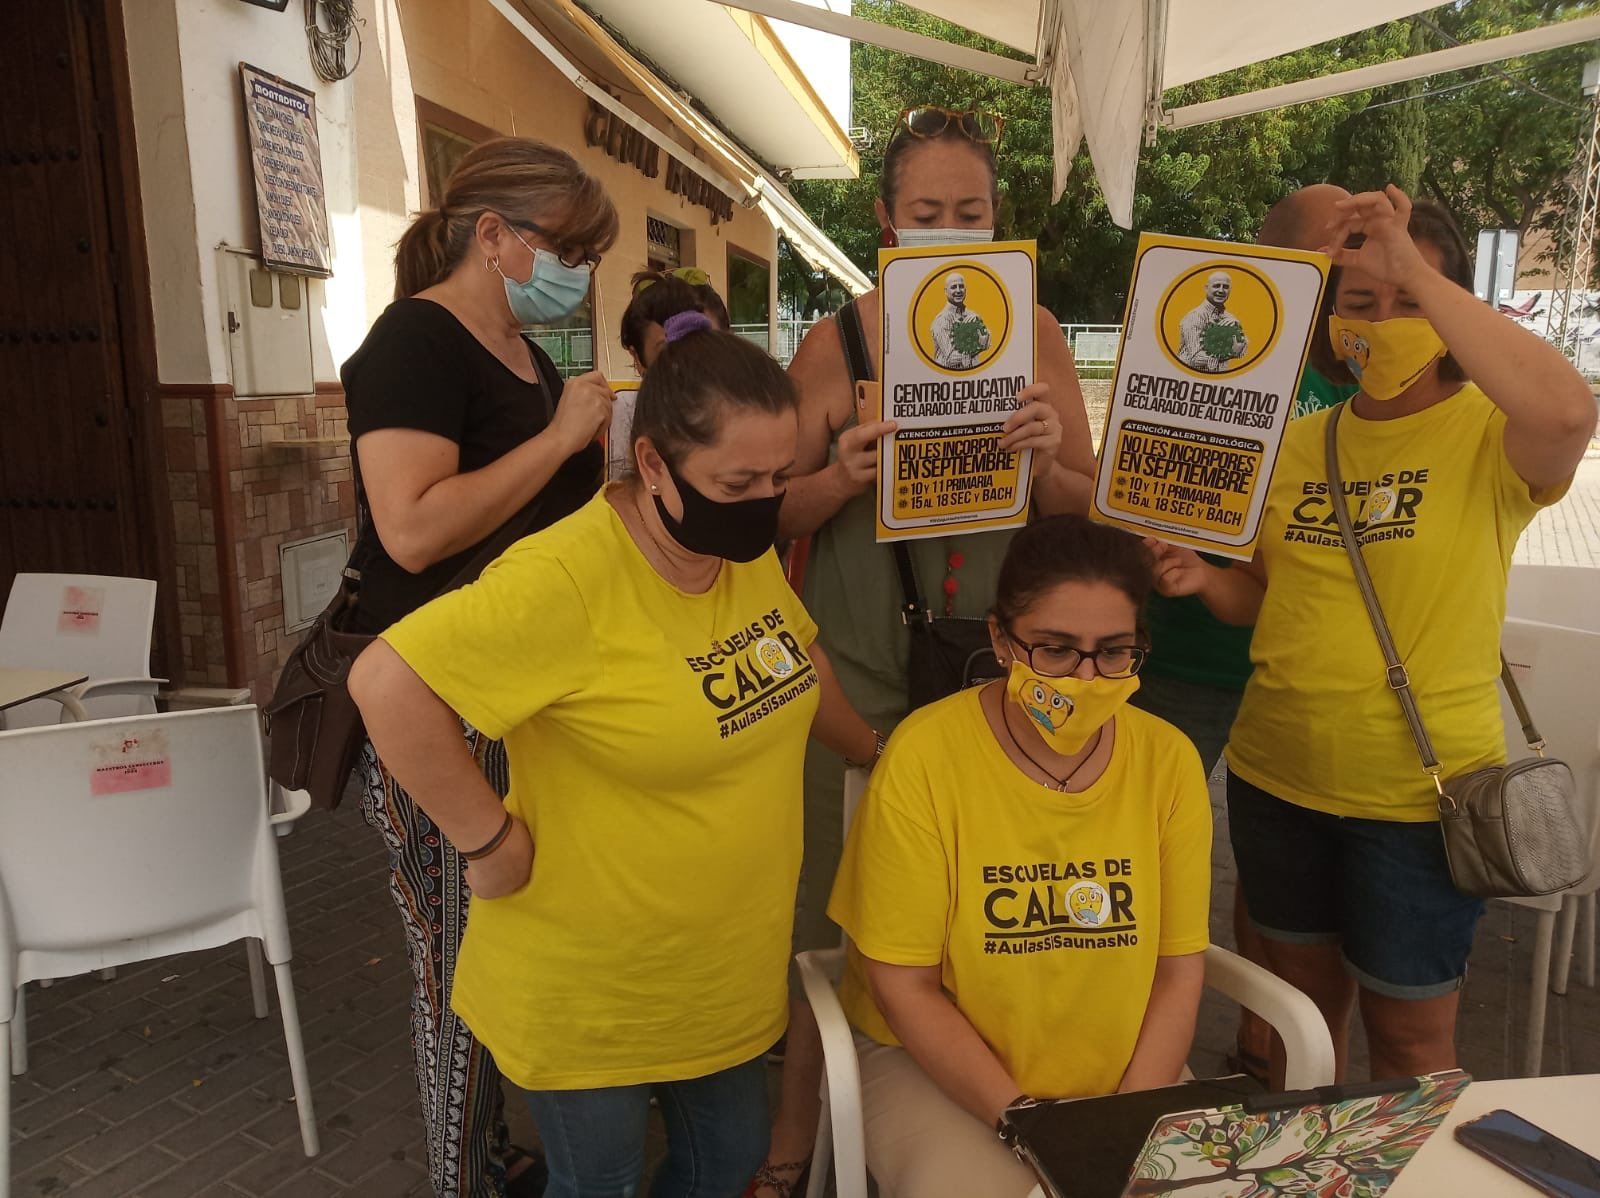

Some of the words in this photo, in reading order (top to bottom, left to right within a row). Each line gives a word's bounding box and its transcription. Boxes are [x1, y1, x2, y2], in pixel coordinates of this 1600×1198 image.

[254, 83, 307, 112] MONTADITOS
[893, 381, 950, 404] CENTRO
[952, 375, 1026, 401] EDUCATIVO
[1126, 372, 1190, 401] CENTRO
[1189, 381, 1279, 414] EDUCATIVO
[893, 400, 951, 418] DECLARADO
[953, 401, 967, 415] DE
[967, 399, 993, 414] ALTO
[1123, 393, 1188, 416] DECLARADO
[1188, 402, 1203, 419] DE
[1204, 406, 1233, 424] ALTO
[1233, 411, 1274, 430] RIESGO
[898, 429, 941, 439] ATENCIÓN
[942, 426, 974, 437] ALERTA
[975, 424, 1005, 434] BIOLÓ
[1124, 421, 1171, 437] ATENCIÓN
[1171, 430, 1207, 442] ALERTA
[1209, 435, 1260, 451] BIOLÓGICA
[898, 444, 916, 461] NO
[918, 442, 941, 460] LES
[942, 436, 1004, 457] INCORPO
[1121, 434, 1142, 453] NO
[1142, 438, 1168, 458] LES
[1168, 442, 1256, 474] INCORPORES
[898, 459, 919, 481] EN
[921, 450, 1015, 479] SEPTIEMBRE
[1118, 450, 1143, 474] EN
[1142, 455, 1253, 495] SEPTIEMBRE
[1397, 469, 1429, 484] DE
[911, 482, 923, 496] 10
[923, 484, 929, 495] Y
[933, 480, 944, 494] 11
[945, 475, 993, 493] PRIMARIA
[911, 495, 923, 510] 15
[923, 499, 933, 509] AL
[936, 493, 949, 507] 18
[950, 491, 972, 506] SEC
[974, 493, 981, 503] Y
[982, 486, 1013, 502] BACH
[1129, 476, 1142, 491] 10
[1142, 481, 1151, 493] Y
[1153, 481, 1165, 497] 11
[1166, 484, 1222, 507] PRIMARIA
[1127, 491, 1140, 506] 15
[1139, 497, 1151, 508] AL
[1154, 497, 1169, 512] 18
[1169, 500, 1194, 517] SEC
[1196, 508, 1205, 520] Y
[1206, 507, 1243, 527] BACH
[685, 621, 765, 673] ESCUELAS
[762, 607, 785, 631] DE
[702, 630, 809, 709] CALOR
[983, 861, 1097, 884] ESCUELAS
[1104, 858, 1132, 877] DE
[983, 880, 1136, 929] CALOR
[983, 933, 1138, 955] #AulasSiSaunasNo
